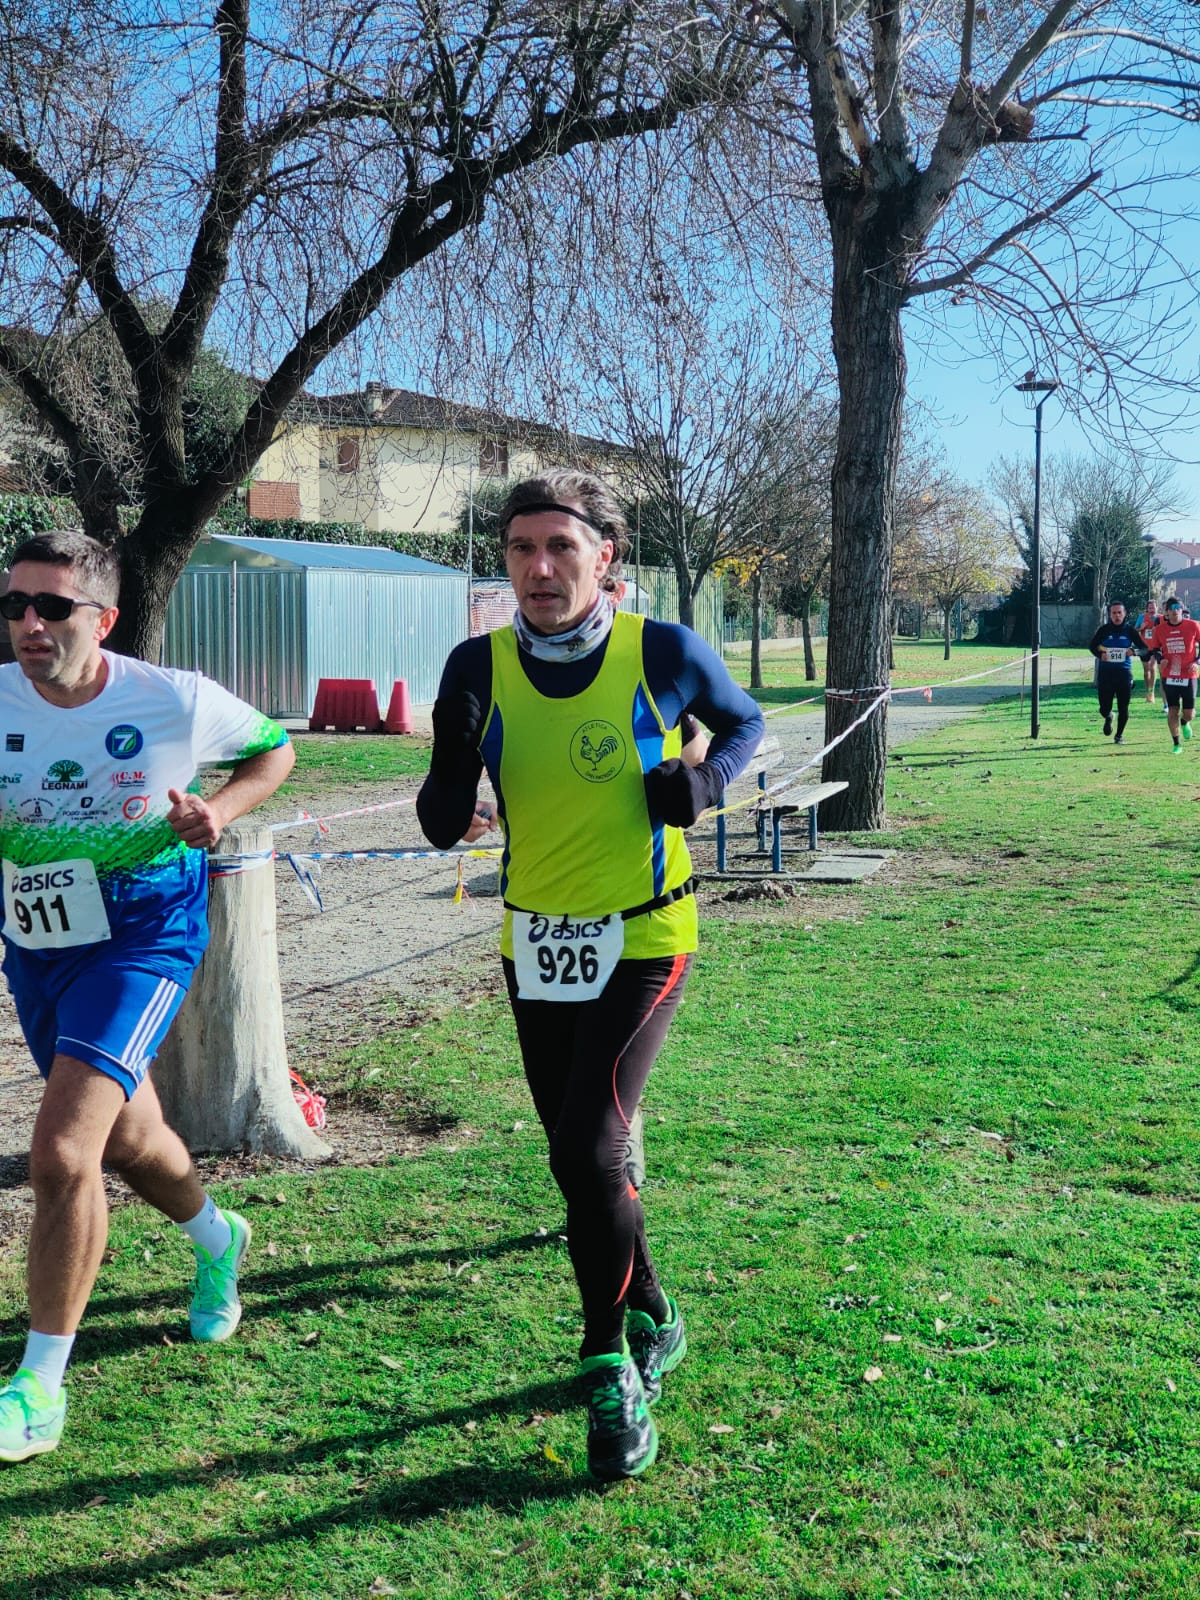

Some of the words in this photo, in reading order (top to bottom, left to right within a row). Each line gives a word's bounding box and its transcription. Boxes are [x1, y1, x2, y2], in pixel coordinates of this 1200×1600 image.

[115, 733, 134, 752] 7
[14, 894, 71, 935] 911
[537, 945, 599, 985] 926
